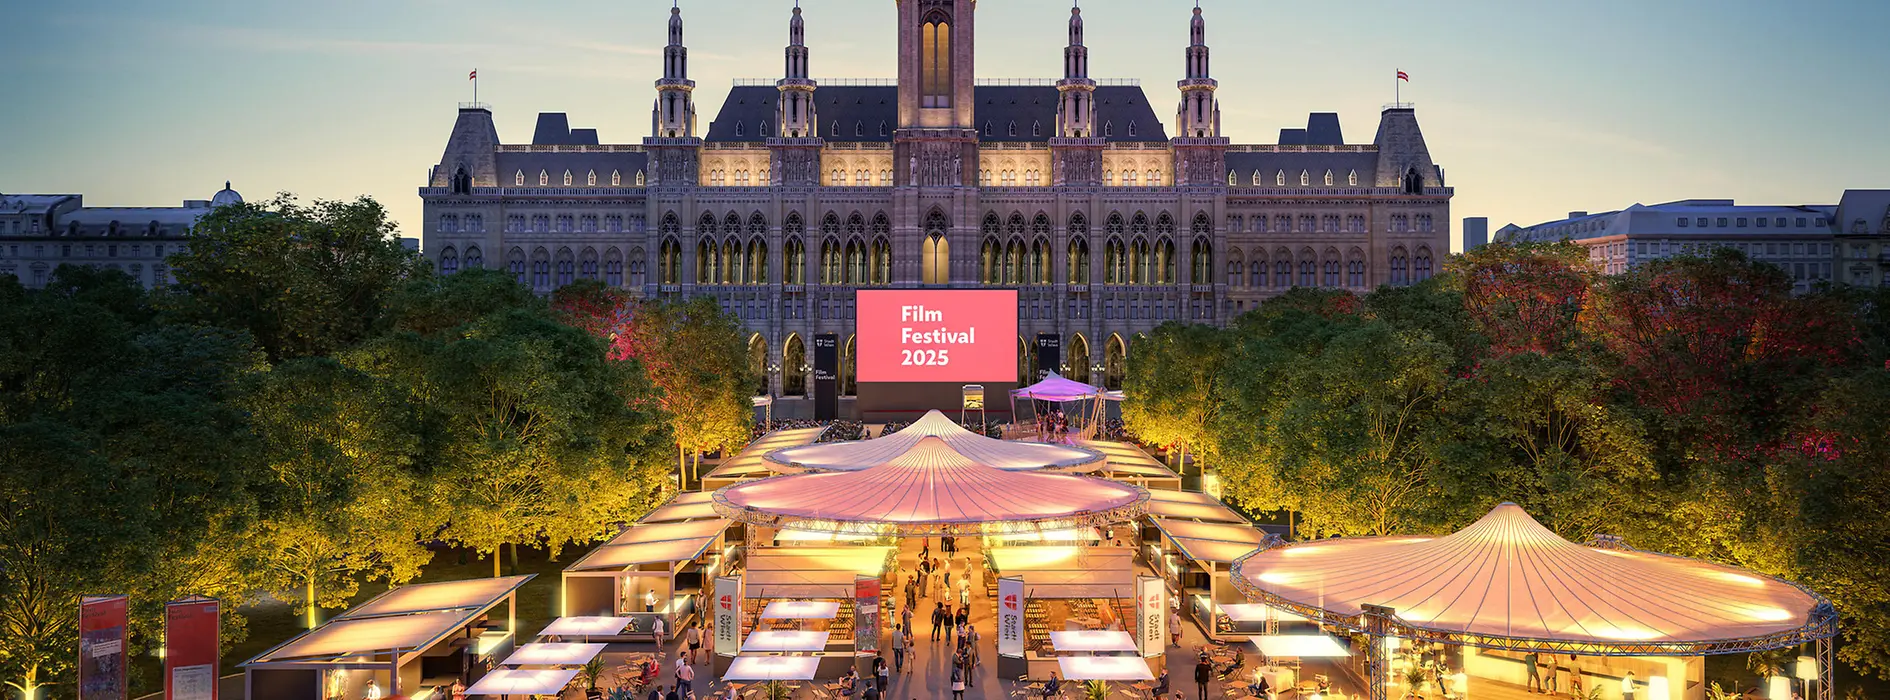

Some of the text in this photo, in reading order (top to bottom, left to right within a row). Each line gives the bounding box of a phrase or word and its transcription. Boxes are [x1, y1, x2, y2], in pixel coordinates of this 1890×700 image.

[901, 305, 943, 322] Film
[901, 327, 975, 344] Festival
[901, 349, 949, 366] 2025
[1010, 614, 1018, 641] Stadt
